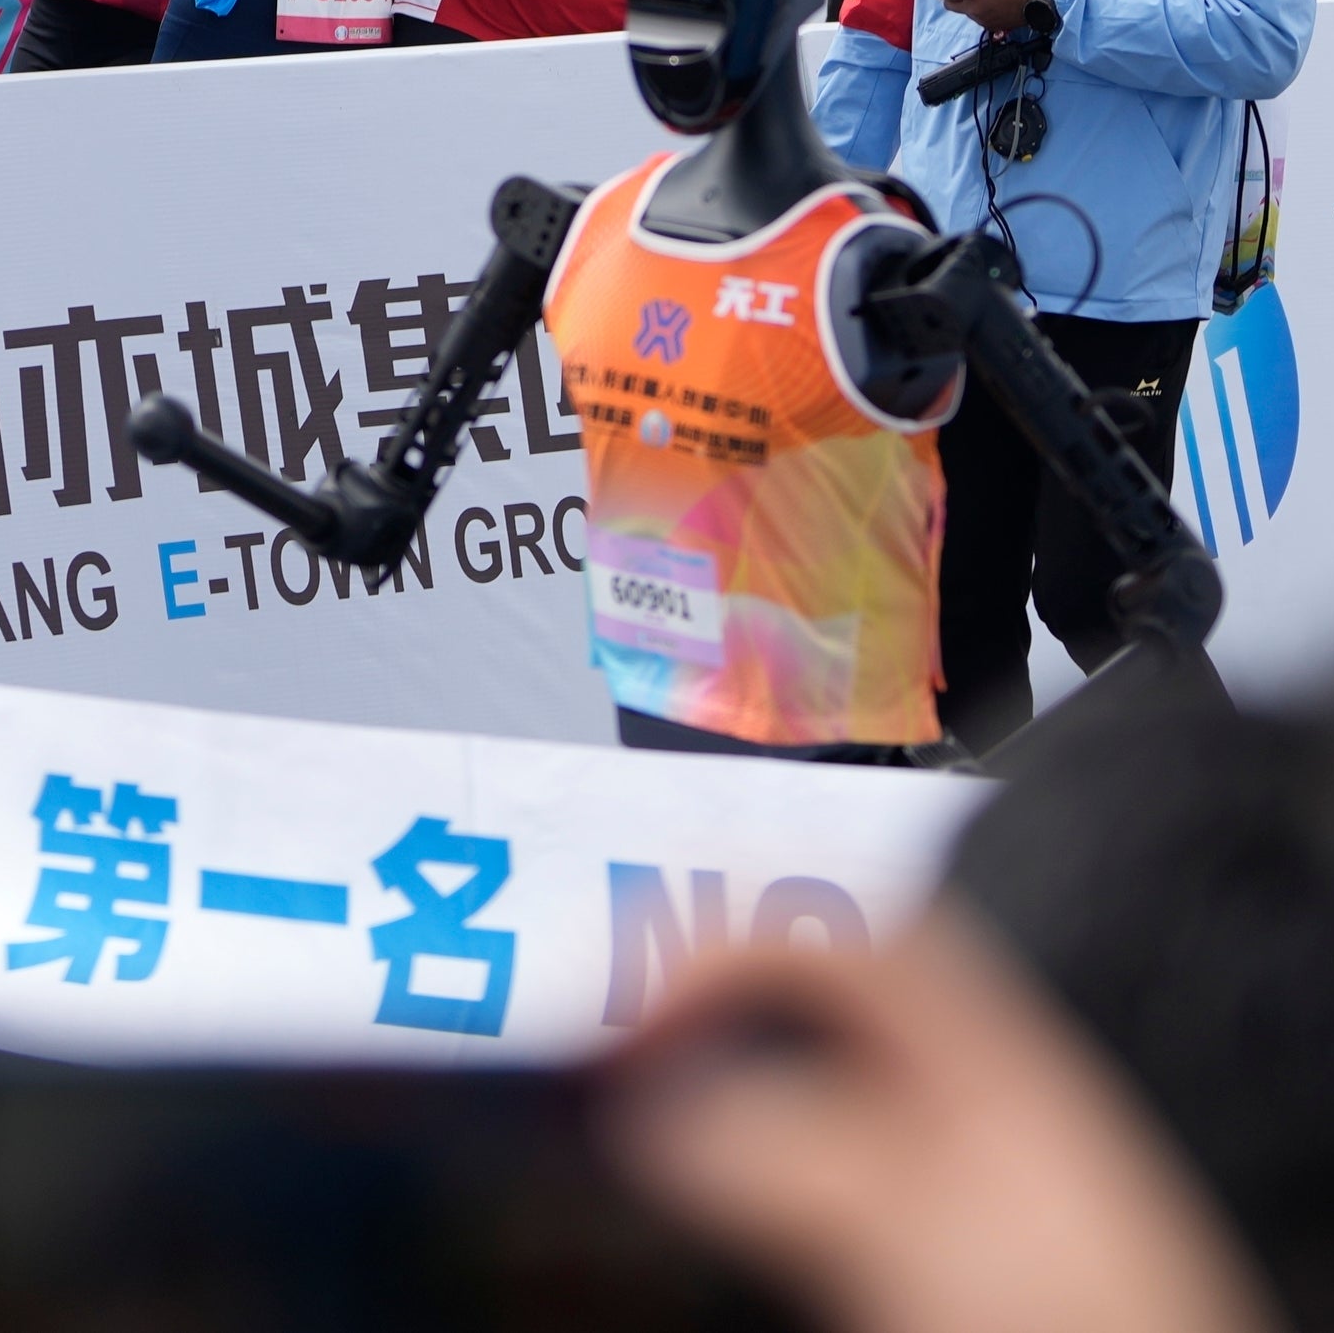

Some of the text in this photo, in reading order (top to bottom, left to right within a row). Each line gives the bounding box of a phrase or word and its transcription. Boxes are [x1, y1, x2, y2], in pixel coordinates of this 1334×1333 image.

[713, 275, 799, 326] 天工
[453, 495, 589, 584] GRO
[610, 574, 694, 622] 60901
[4, 772, 517, 1039] 第一名
